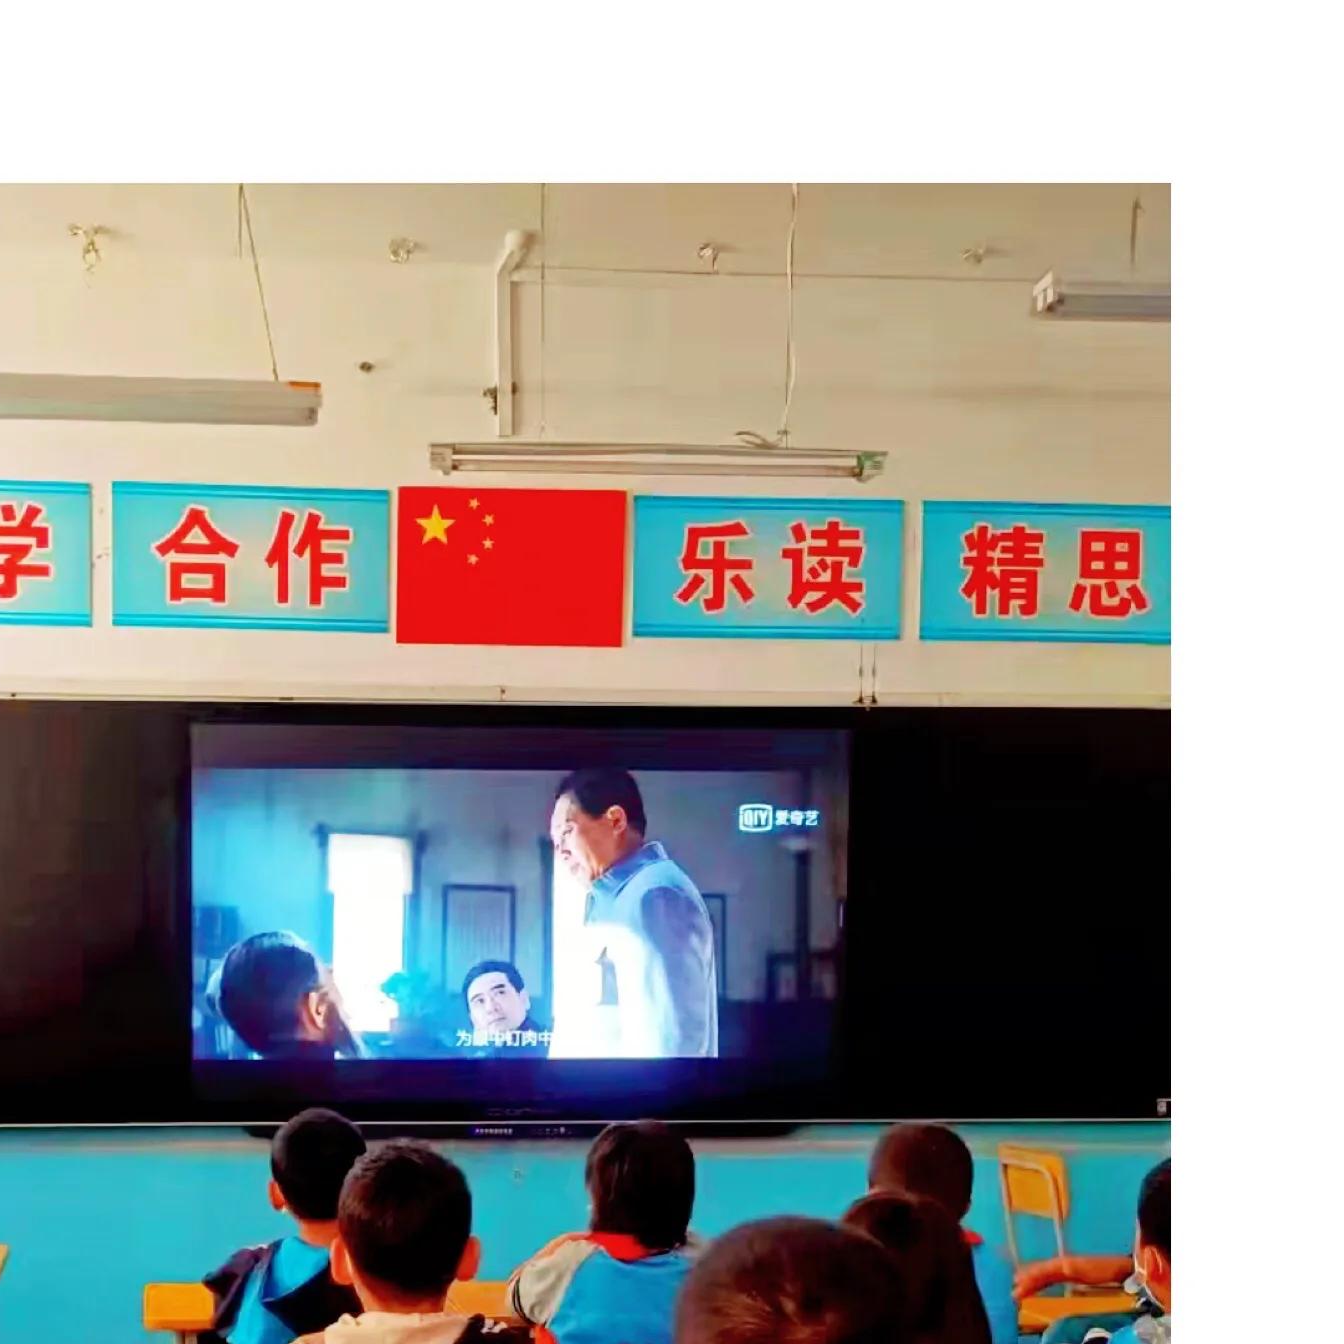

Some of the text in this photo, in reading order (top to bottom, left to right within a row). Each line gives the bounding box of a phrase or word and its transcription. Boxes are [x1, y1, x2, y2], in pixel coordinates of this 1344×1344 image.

[154, 507, 351, 607] 合作
[677, 520, 865, 614] 乐读
[961, 523, 1148, 619] 精思
